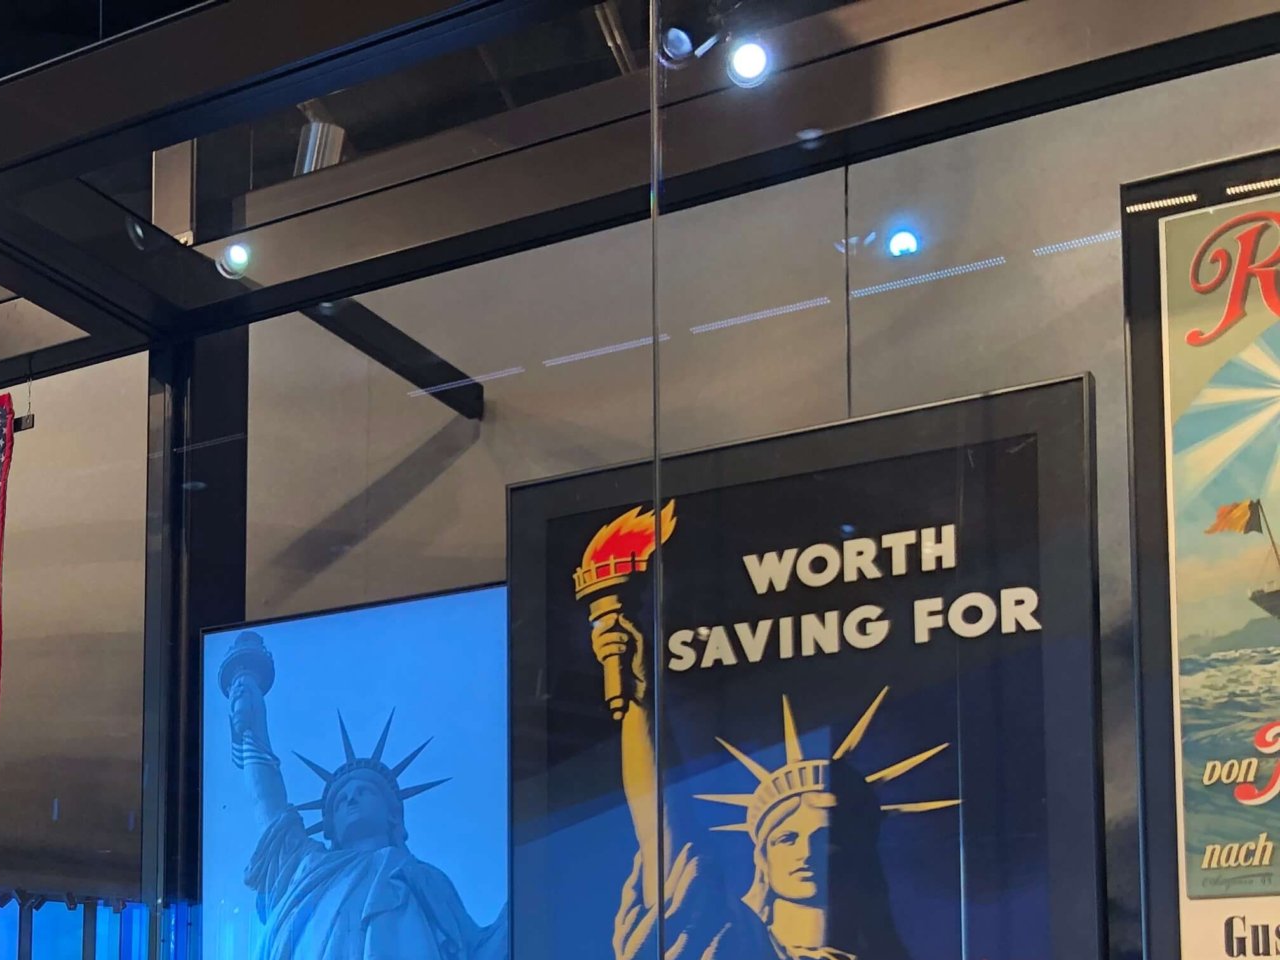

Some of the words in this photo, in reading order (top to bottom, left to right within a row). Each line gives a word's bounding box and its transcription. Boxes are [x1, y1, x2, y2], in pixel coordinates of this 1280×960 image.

[743, 524, 957, 595] WORTH
[667, 604, 891, 672] SAVING
[913, 586, 1043, 644] FOR
[1202, 757, 1259, 787] von
[1201, 831, 1274, 871] nach
